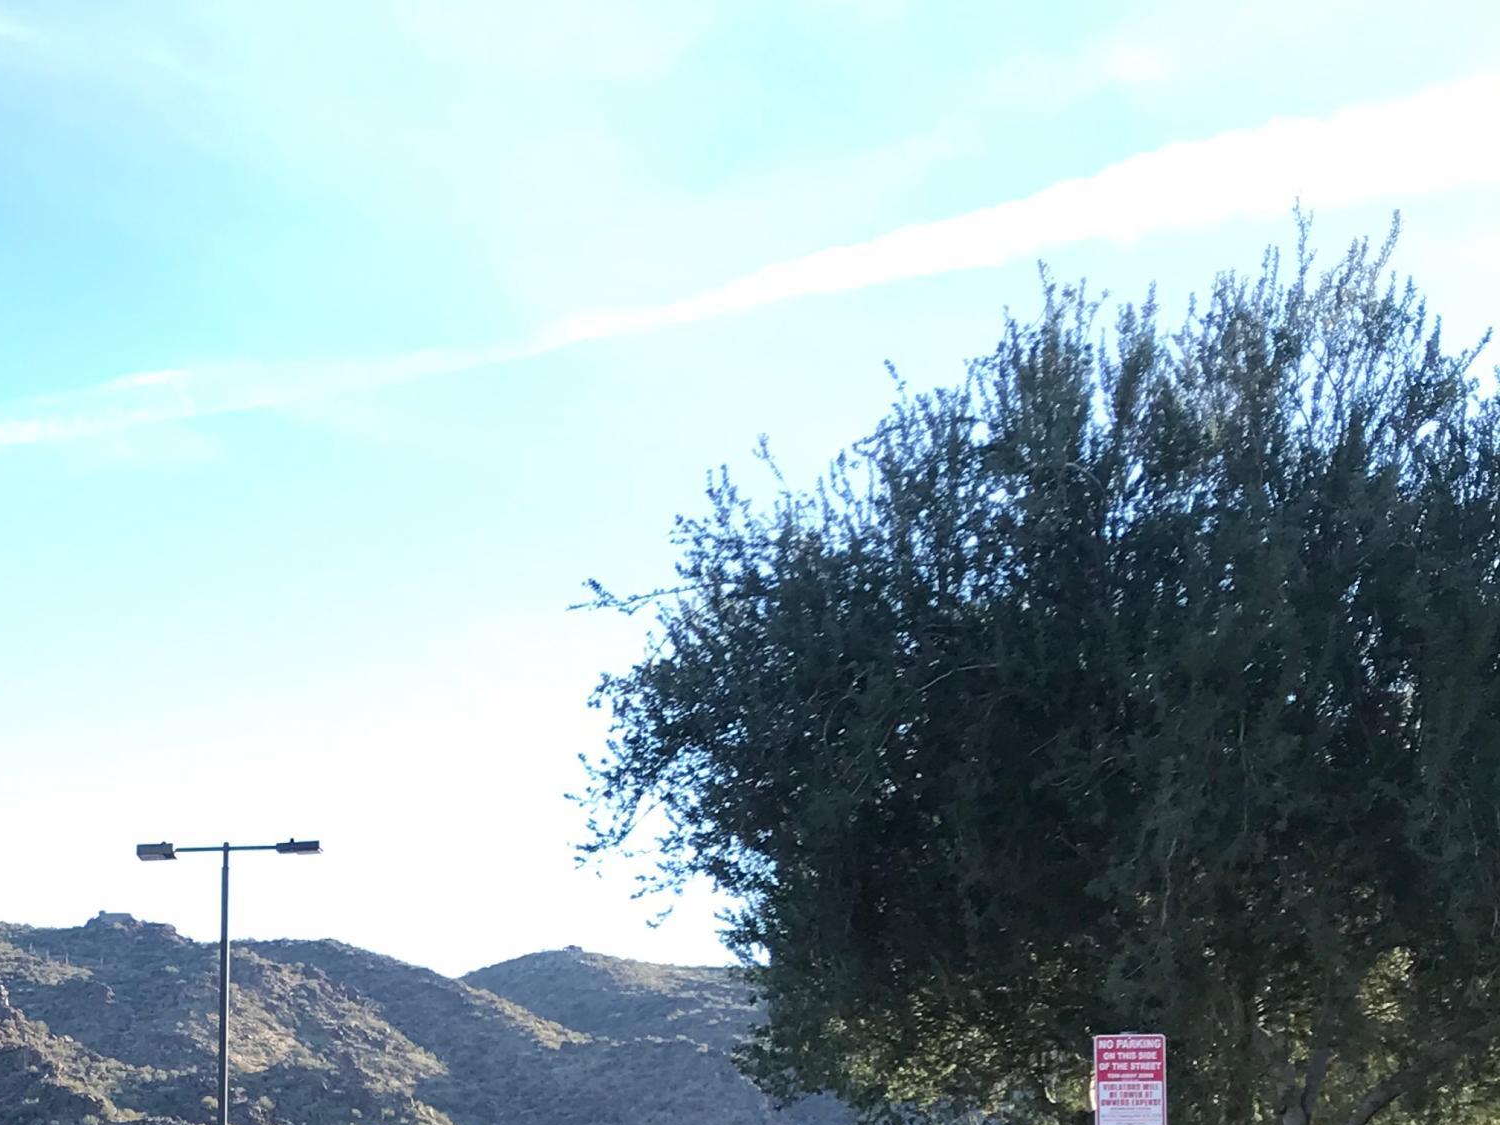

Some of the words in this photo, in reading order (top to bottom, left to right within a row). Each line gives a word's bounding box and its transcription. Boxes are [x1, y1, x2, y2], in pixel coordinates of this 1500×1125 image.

[1098, 1039, 1114, 1049] NO
[1116, 1039, 1162, 1049] PARKING
[1103, 1052, 1116, 1060] ON
[1117, 1052, 1137, 1060] THIS
[1138, 1052, 1157, 1060] SIDE
[1098, 1062, 1110, 1071] OF
[1112, 1062, 1128, 1070] THE
[1130, 1062, 1162, 1070] STREET
